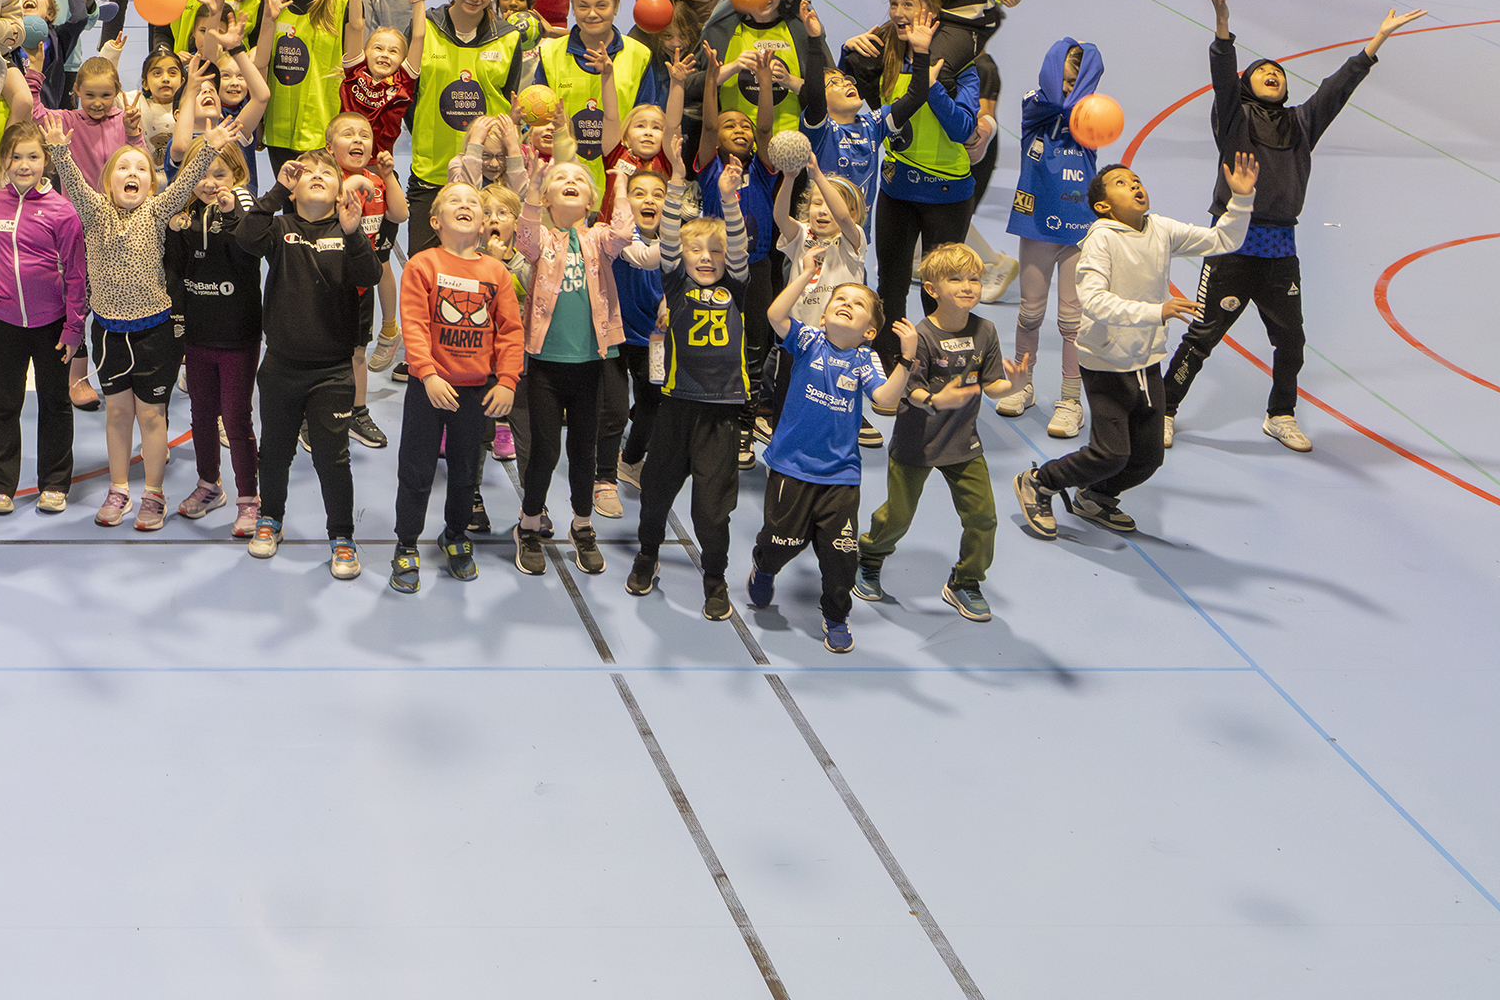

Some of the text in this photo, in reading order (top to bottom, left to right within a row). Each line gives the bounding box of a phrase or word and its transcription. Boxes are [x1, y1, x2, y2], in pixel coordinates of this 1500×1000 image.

[279, 46, 302, 55] REMA
[451, 91, 480, 100] REMA
[454, 100, 476, 109] 1000
[1062, 168, 1084, 182] INC
[688, 309, 730, 347] 28
[439, 328, 484, 349] MARVEL
[805, 383, 848, 407] SpareBank
